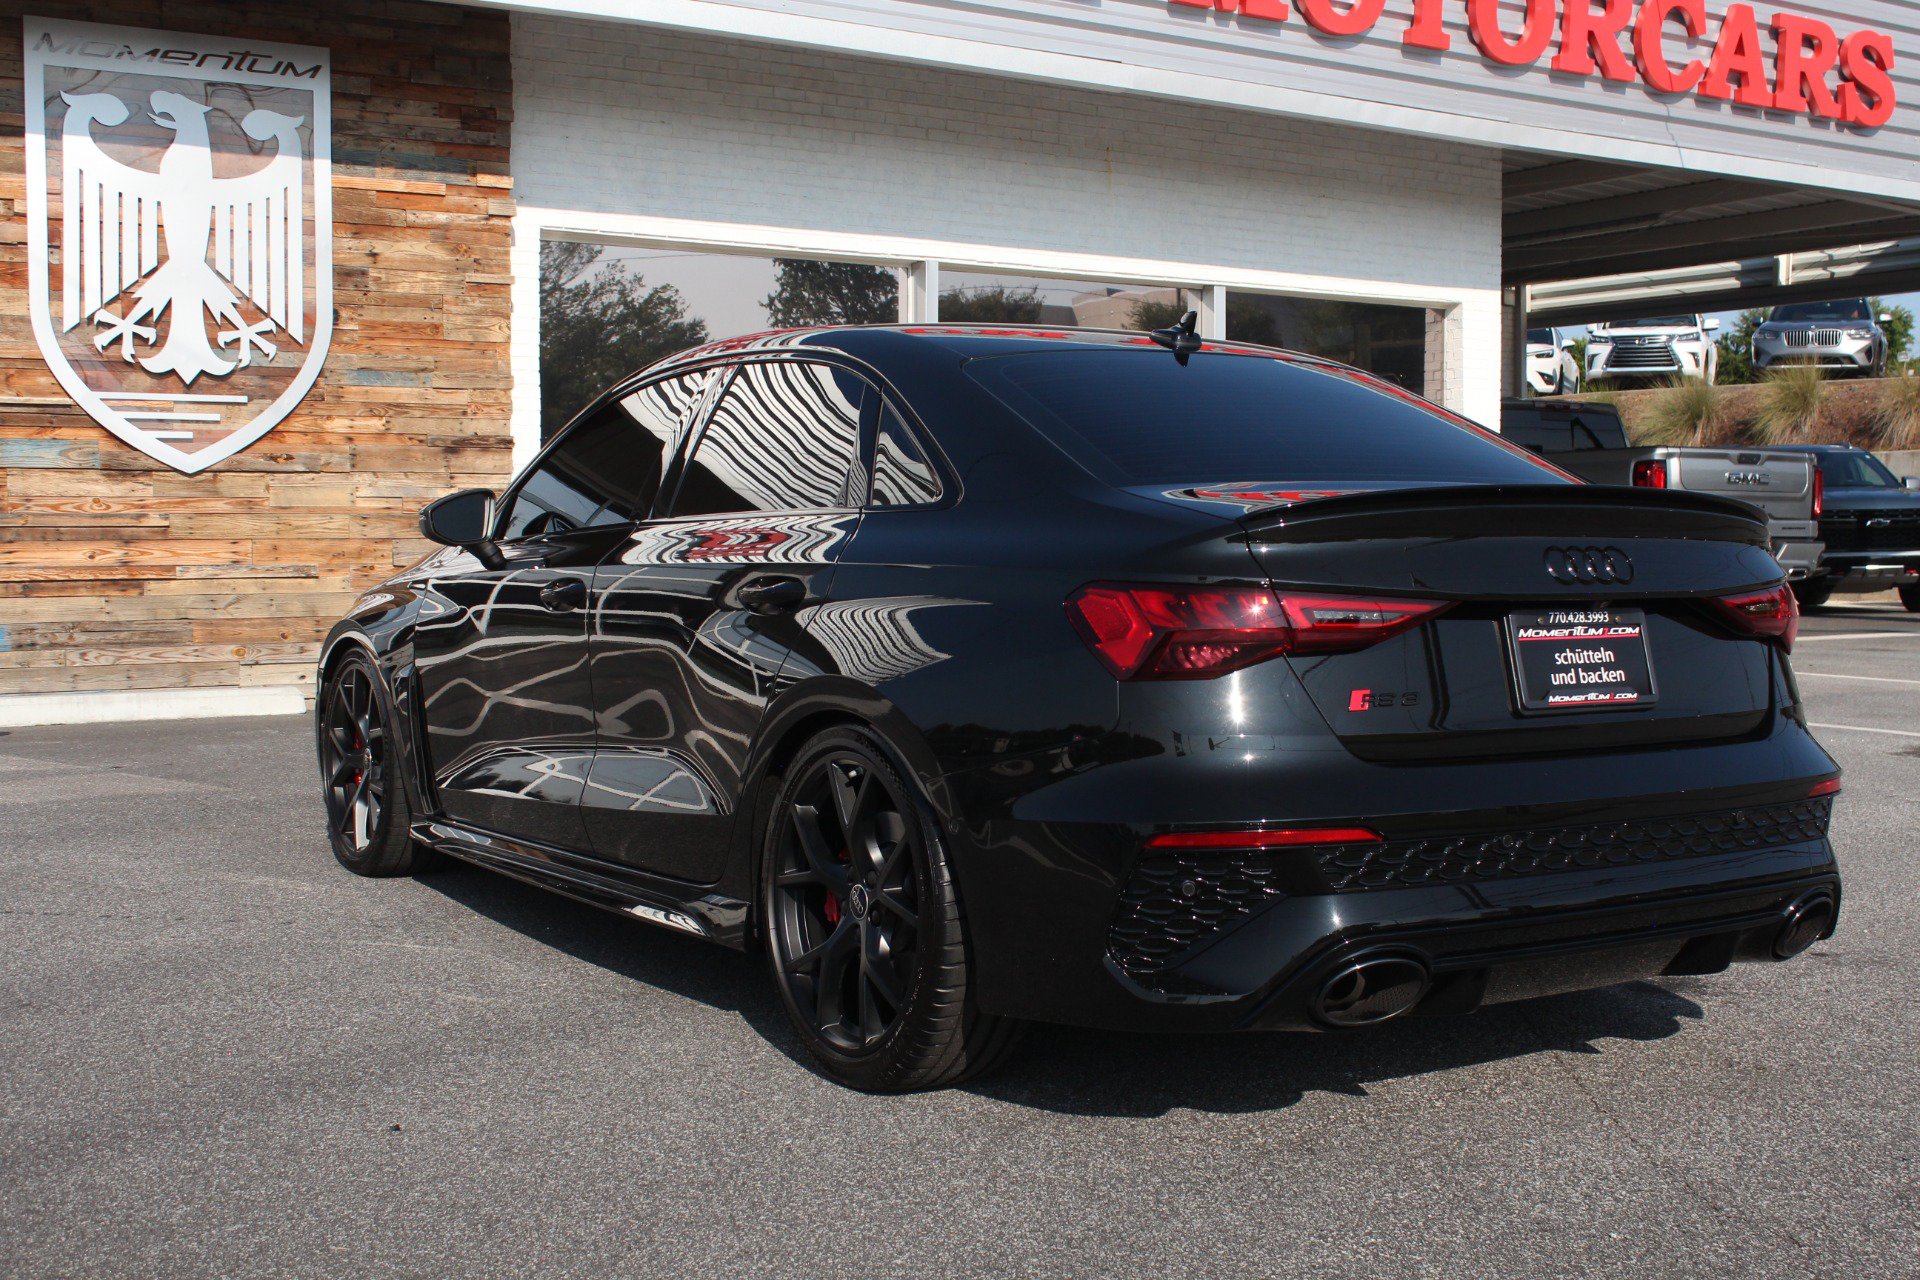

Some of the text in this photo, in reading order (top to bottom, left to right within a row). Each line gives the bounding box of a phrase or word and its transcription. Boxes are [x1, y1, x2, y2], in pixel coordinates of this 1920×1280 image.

[1168, 0, 1896, 128] ORCARS
[1725, 471, 1770, 485] GMC
[1549, 611, 1609, 624] 770.428.3993
[1555, 647, 1615, 665] schütteln
[1551, 667, 1626, 685] und backen
